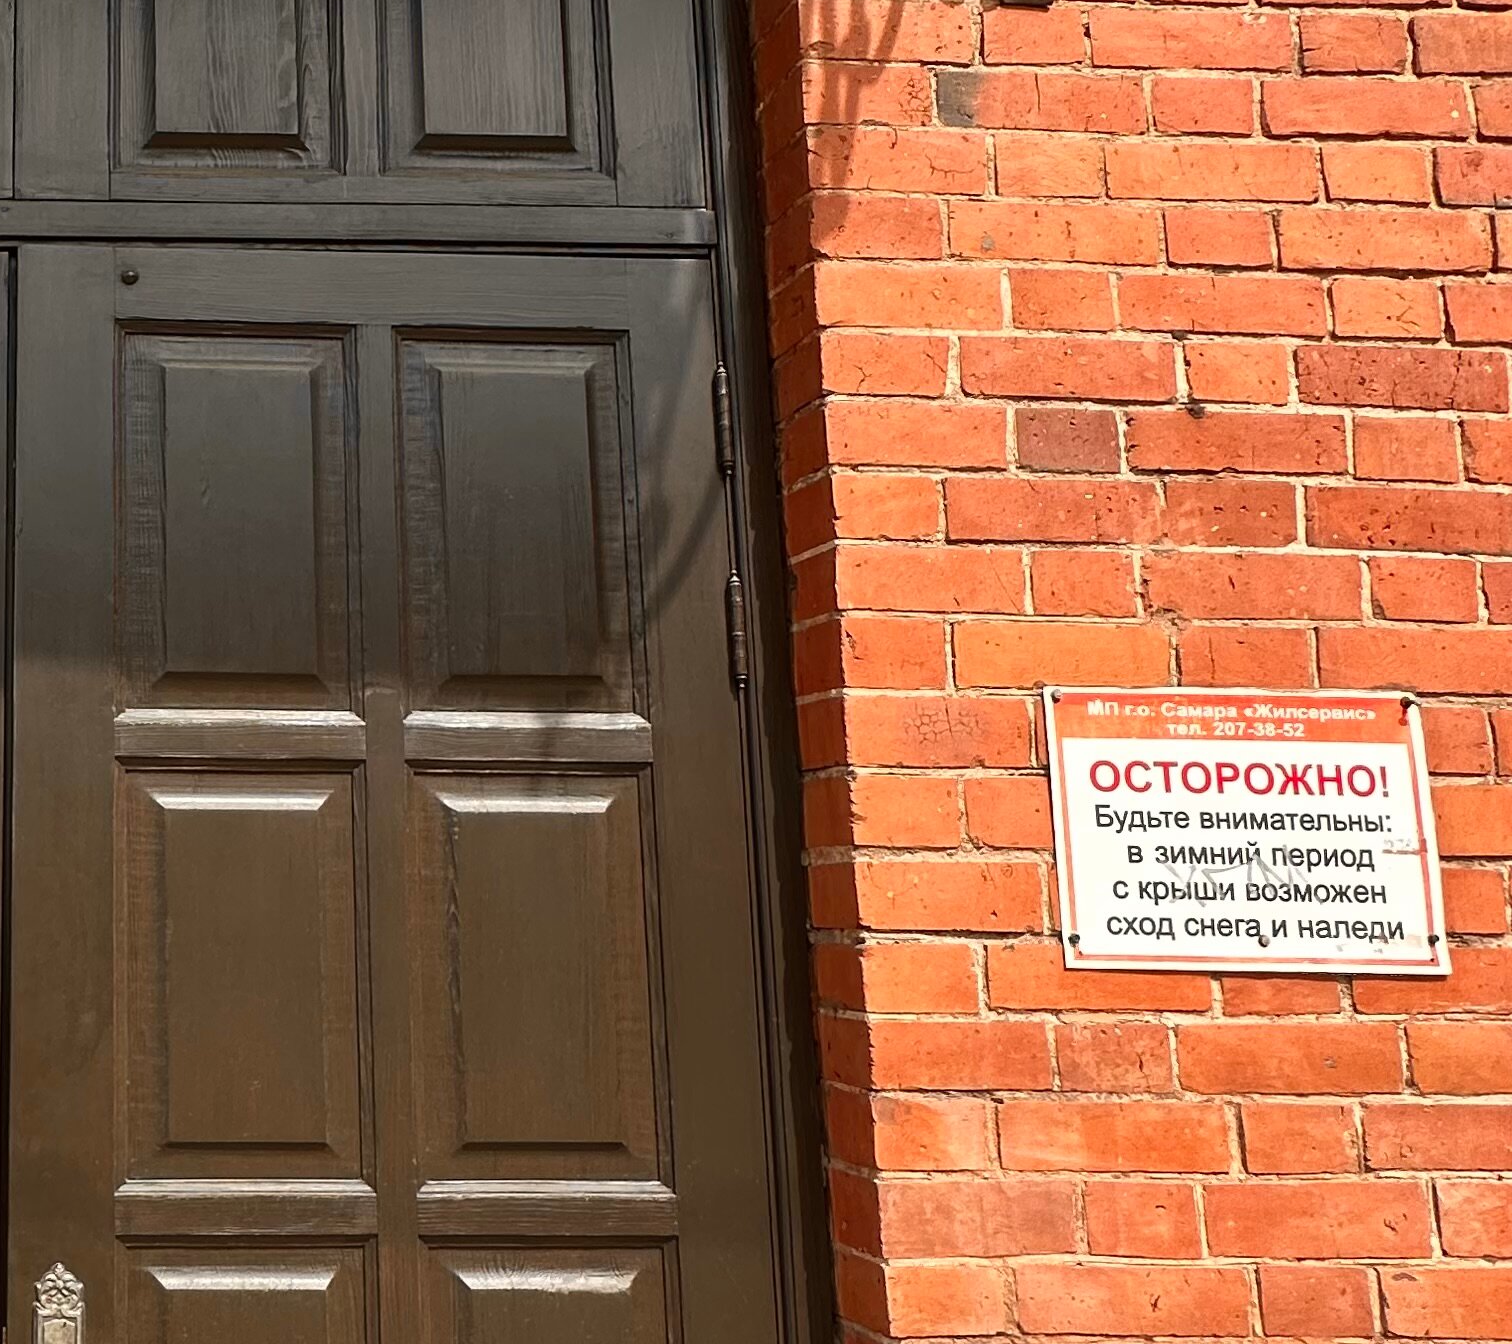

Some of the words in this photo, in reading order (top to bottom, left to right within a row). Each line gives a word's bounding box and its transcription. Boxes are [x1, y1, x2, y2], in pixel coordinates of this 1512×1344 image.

[1160, 703, 1237, 719] Самара
[1167, 723, 1207, 736] тел.
[1213, 721, 1305, 738] 207-38-52
[1089, 760, 1390, 798] ОСТОРОЖНО!
[1094, 804, 1190, 834] Будьте
[1199, 810, 1393, 833] внимательны:
[1127, 845, 1143, 864] в
[1154, 842, 1260, 866] зимний
[1271, 847, 1375, 873] период
[1112, 881, 1129, 899] с
[1138, 881, 1236, 906] крыши
[1245, 884, 1387, 904] возможен
[1106, 914, 1176, 942] сход
[1184, 918, 1262, 938] снега
[1271, 920, 1288, 939] и
[1298, 921, 1405, 942] наледи
